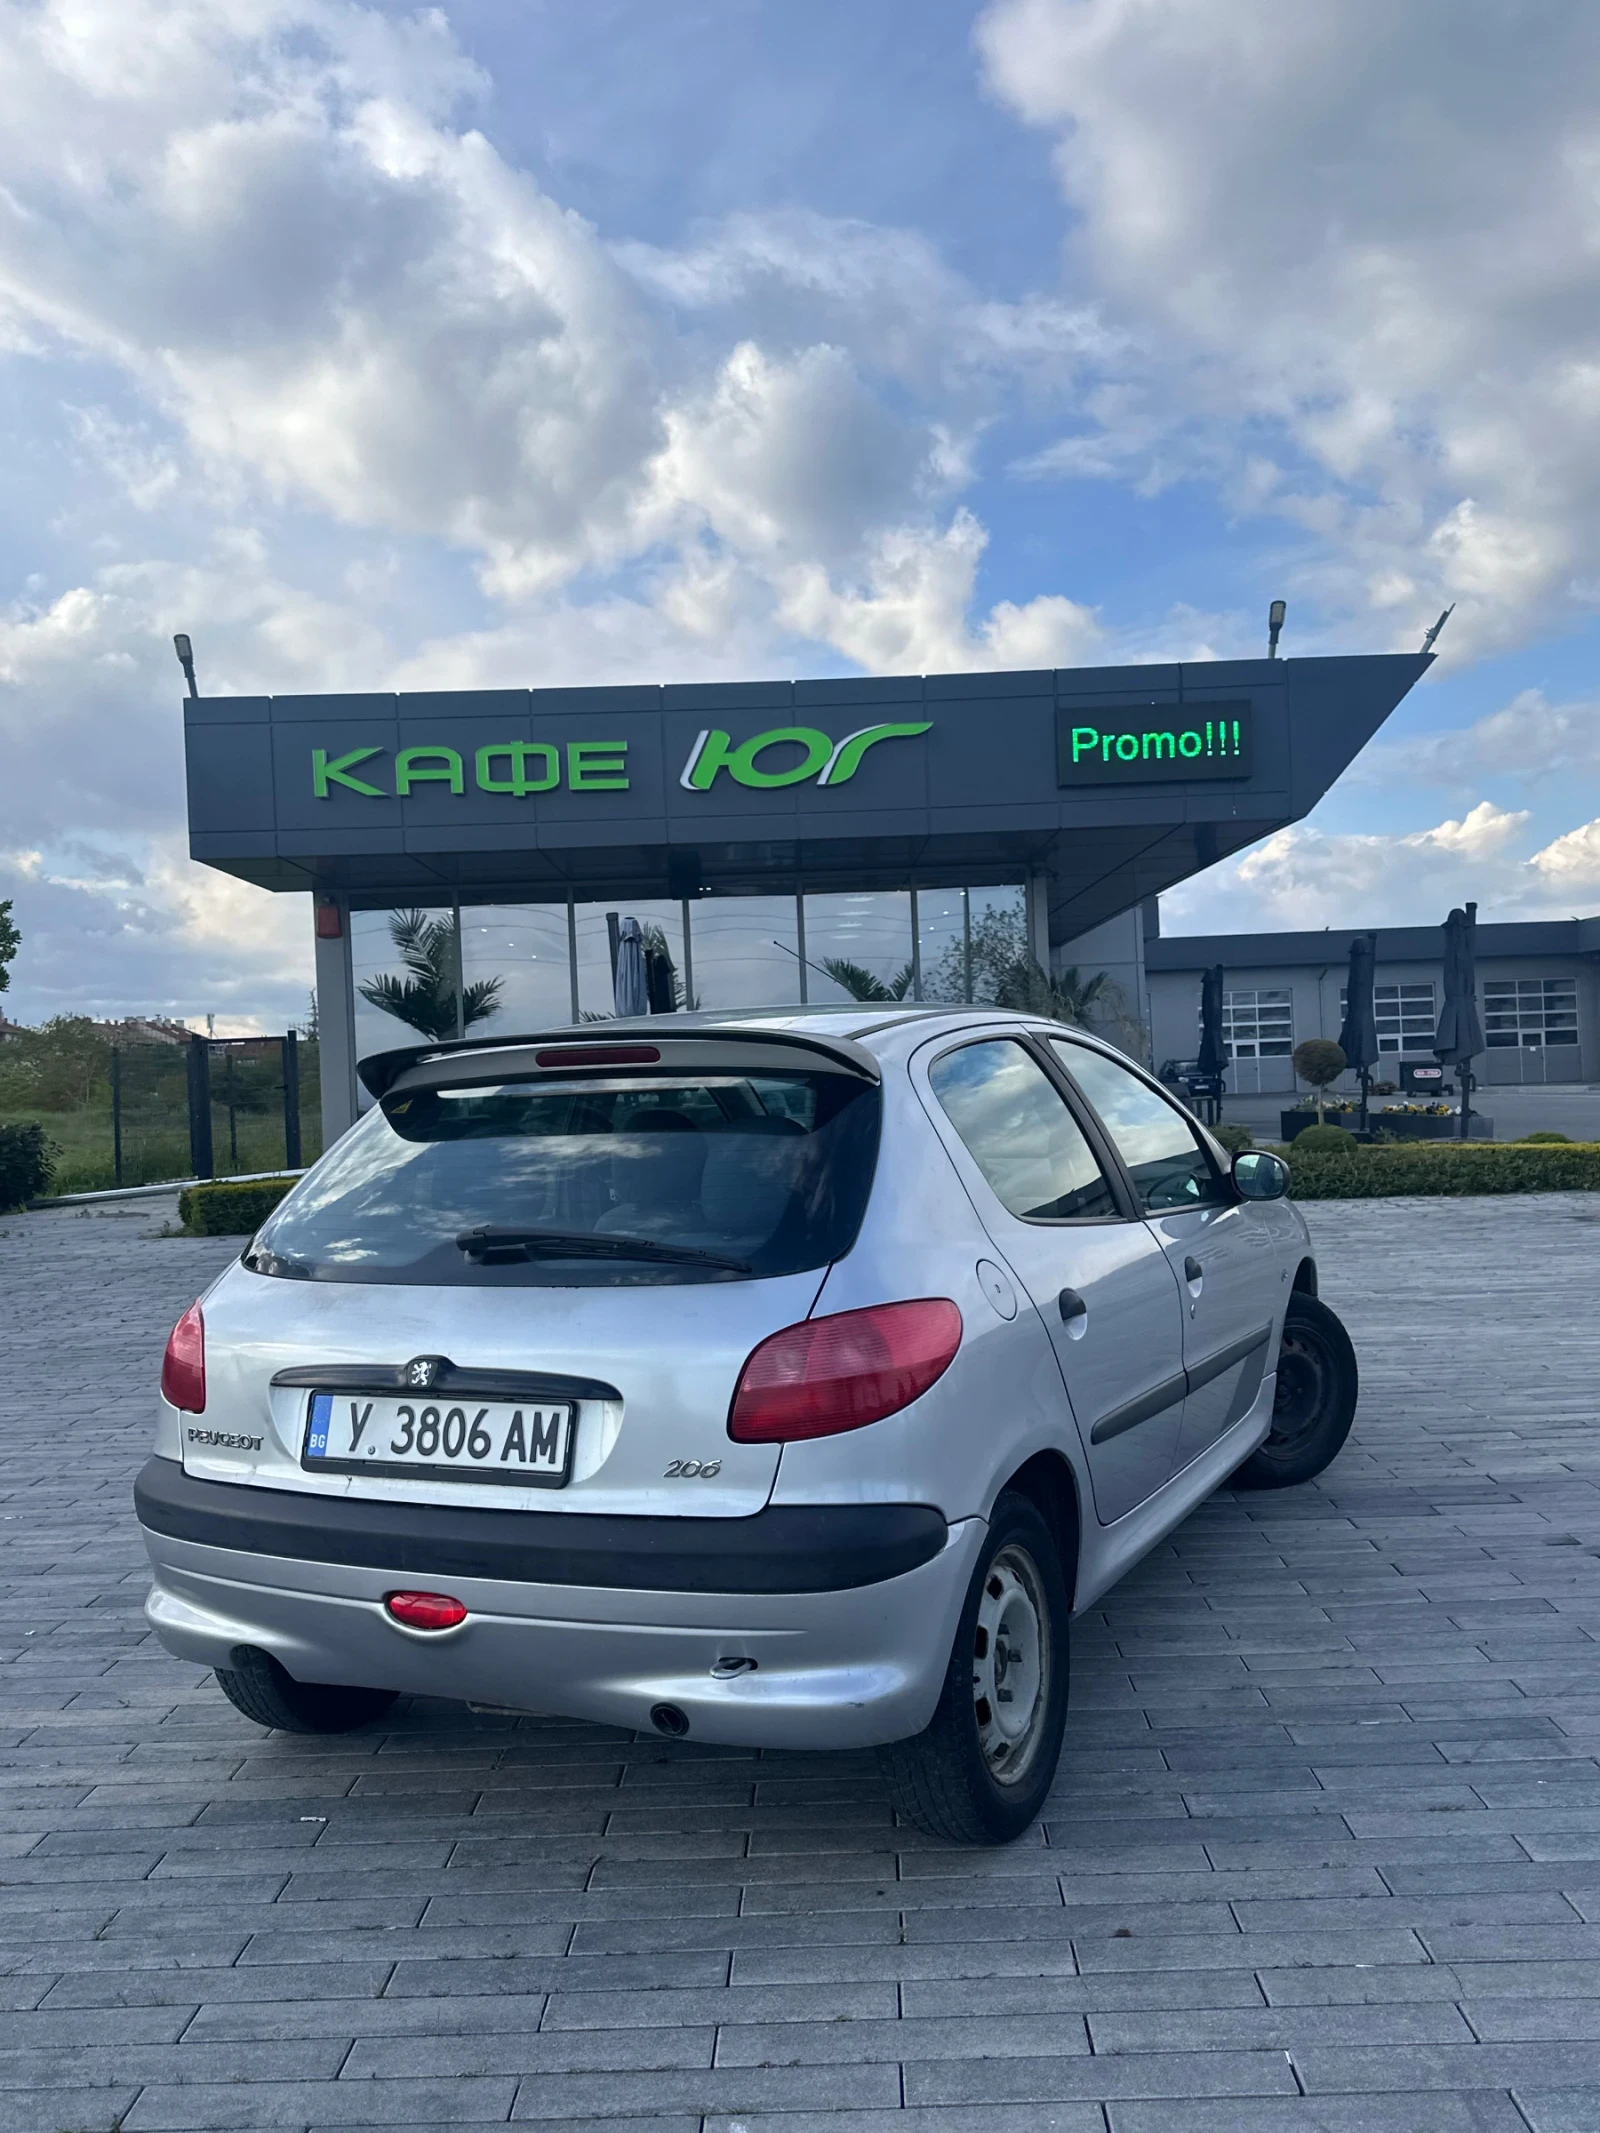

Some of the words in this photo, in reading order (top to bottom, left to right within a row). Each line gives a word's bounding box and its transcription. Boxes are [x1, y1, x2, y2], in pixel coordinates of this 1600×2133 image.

[1071, 720, 1240, 763] Promo!!!
[312, 740, 630, 798] КАФЕ
[187, 1427, 265, 1451] PEUGEOT
[309, 1432, 326, 1449] BG
[390, 1405, 492, 1460] 3806
[500, 1410, 561, 1464] AM
[662, 1459, 723, 1479] 206
